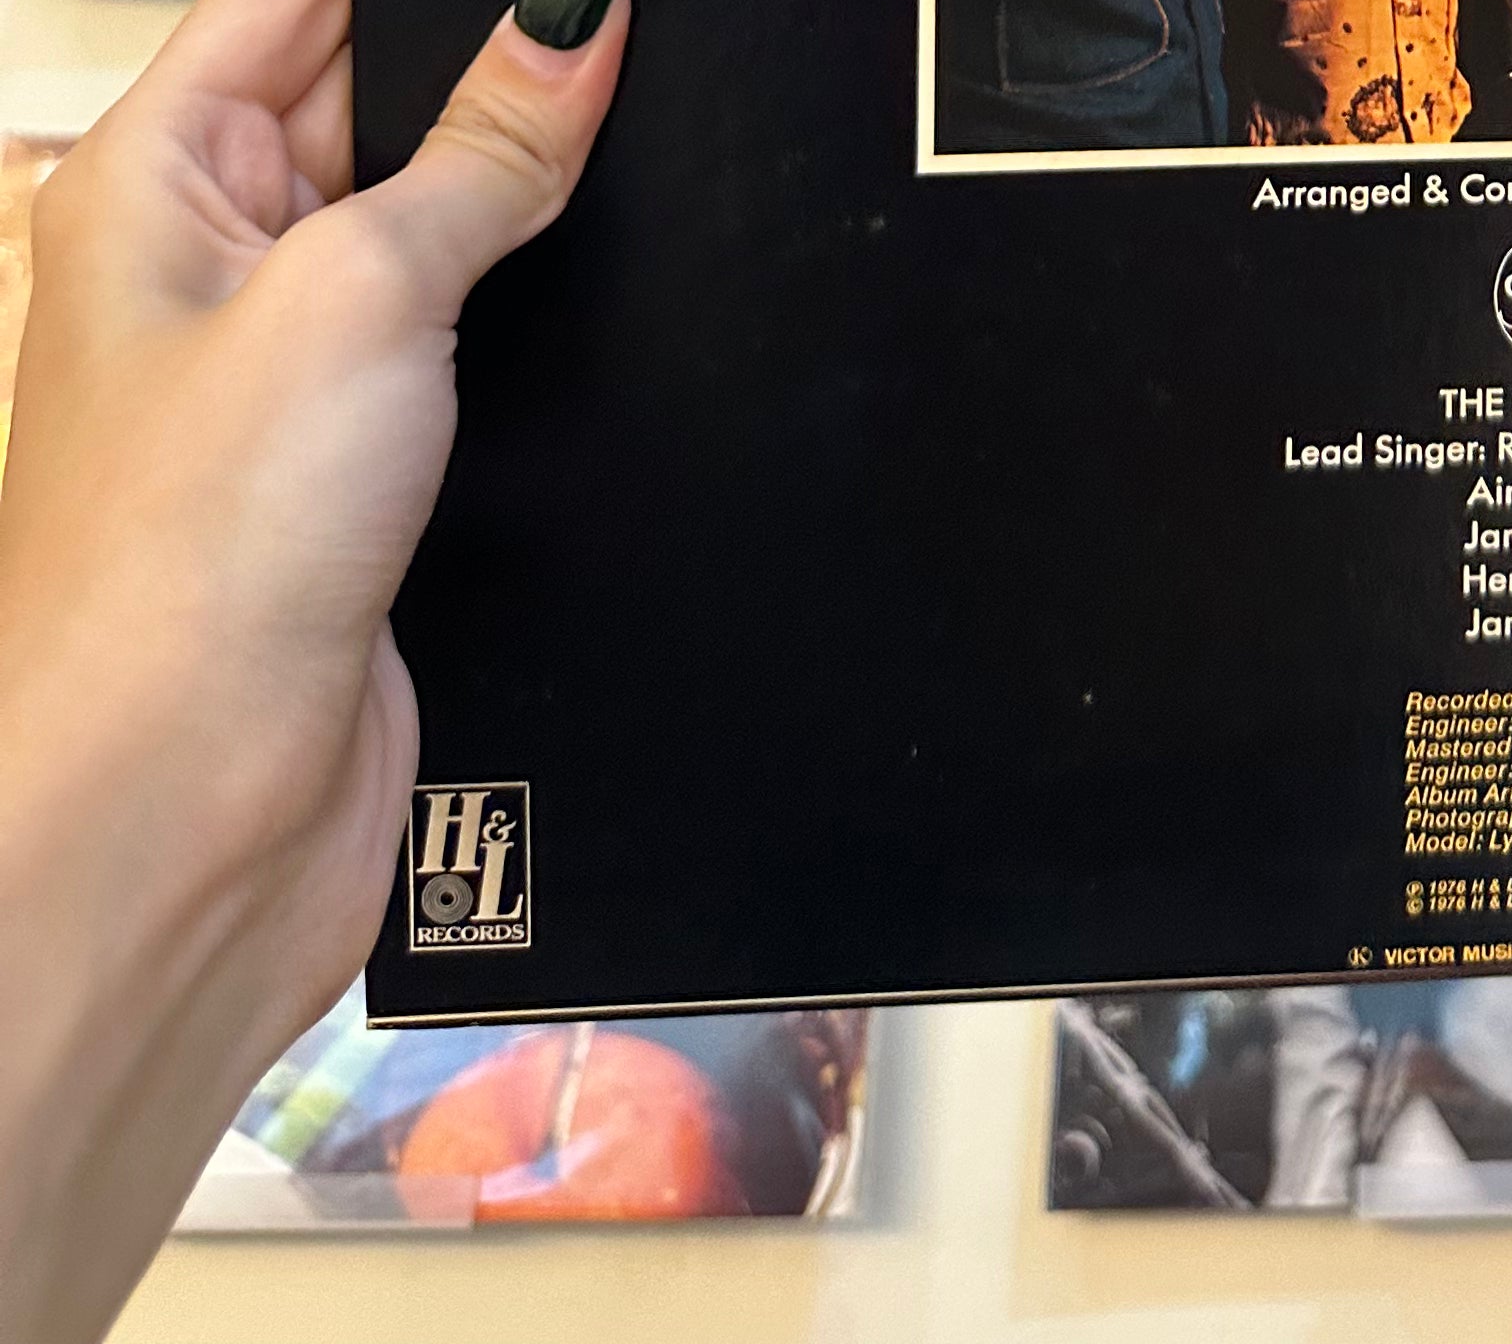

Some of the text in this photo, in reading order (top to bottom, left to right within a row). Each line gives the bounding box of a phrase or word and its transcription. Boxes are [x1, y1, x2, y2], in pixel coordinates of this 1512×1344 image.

[1252, 172, 1411, 213] Arranged
[1422, 174, 1450, 205] &
[1439, 387, 1504, 420] THE
[1285, 432, 1363, 469] Lead
[1375, 434, 1486, 471] Singer:
[1405, 735, 1512, 760] Mastered
[1404, 785, 1478, 807] Album
[1405, 828, 1484, 854] Model:
[417, 924, 525, 944] RECORDS
[1384, 945, 1455, 966] VICTOR
